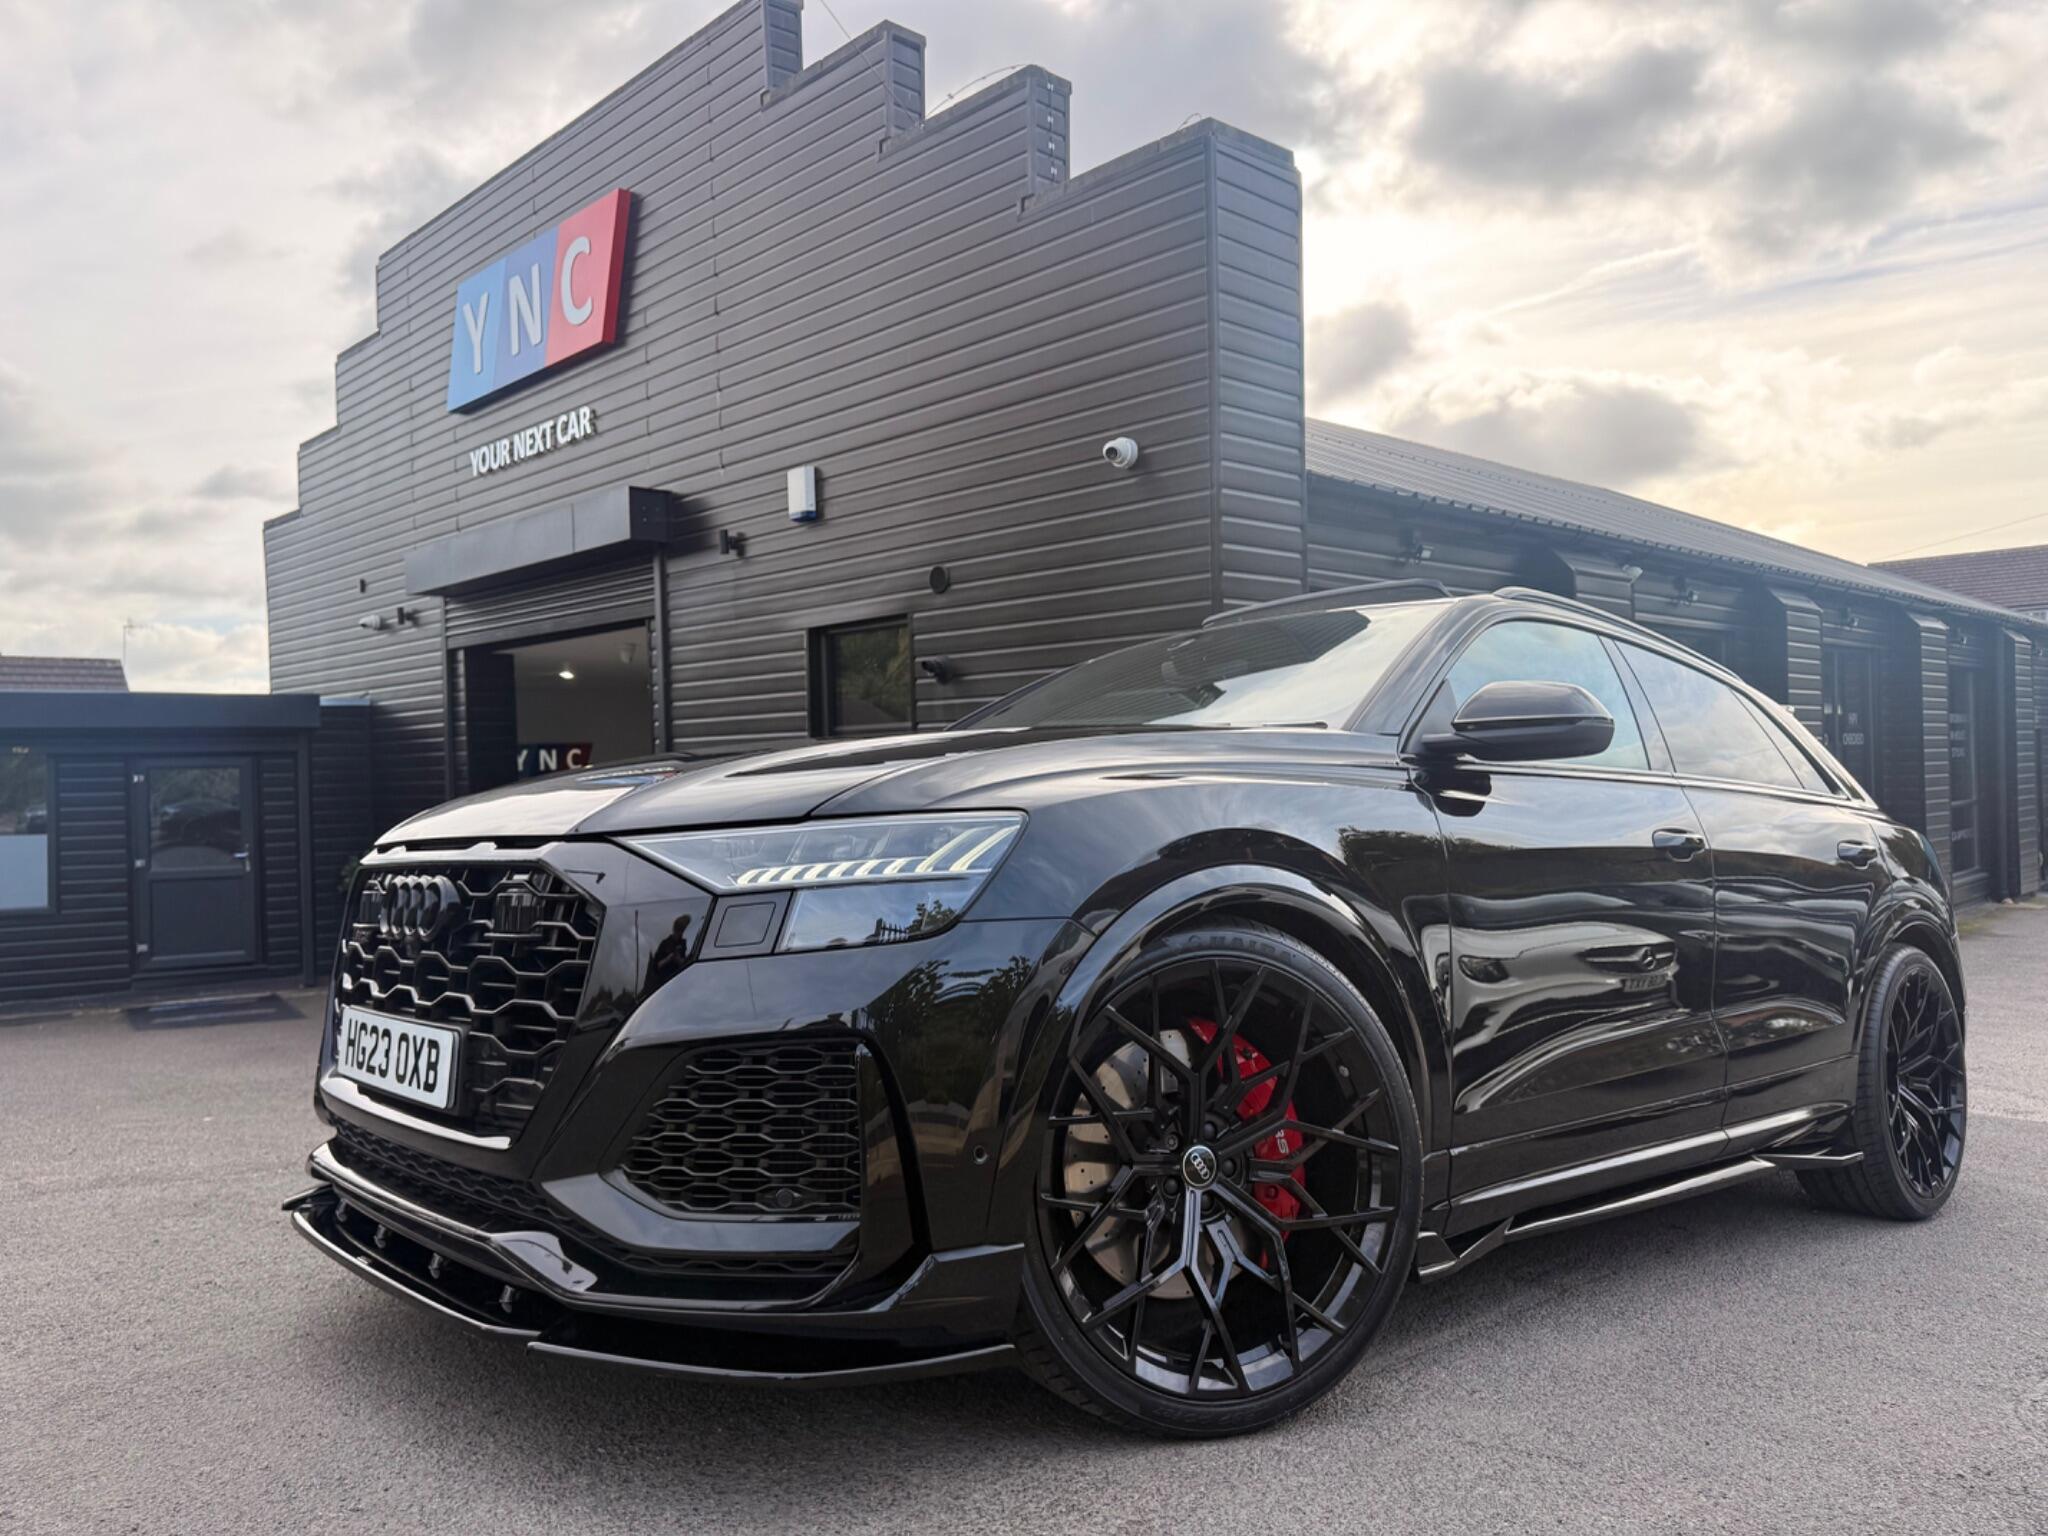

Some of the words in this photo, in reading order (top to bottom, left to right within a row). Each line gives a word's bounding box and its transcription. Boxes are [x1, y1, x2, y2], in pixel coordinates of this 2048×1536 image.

[462, 235, 593, 374] YNC
[469, 440, 510, 477] YOUR
[513, 420, 554, 460] NEXT
[556, 406, 592, 444] CAR
[516, 749, 582, 771] YNC
[344, 1018, 391, 1079] HG23
[395, 1032, 441, 1094] OXB
